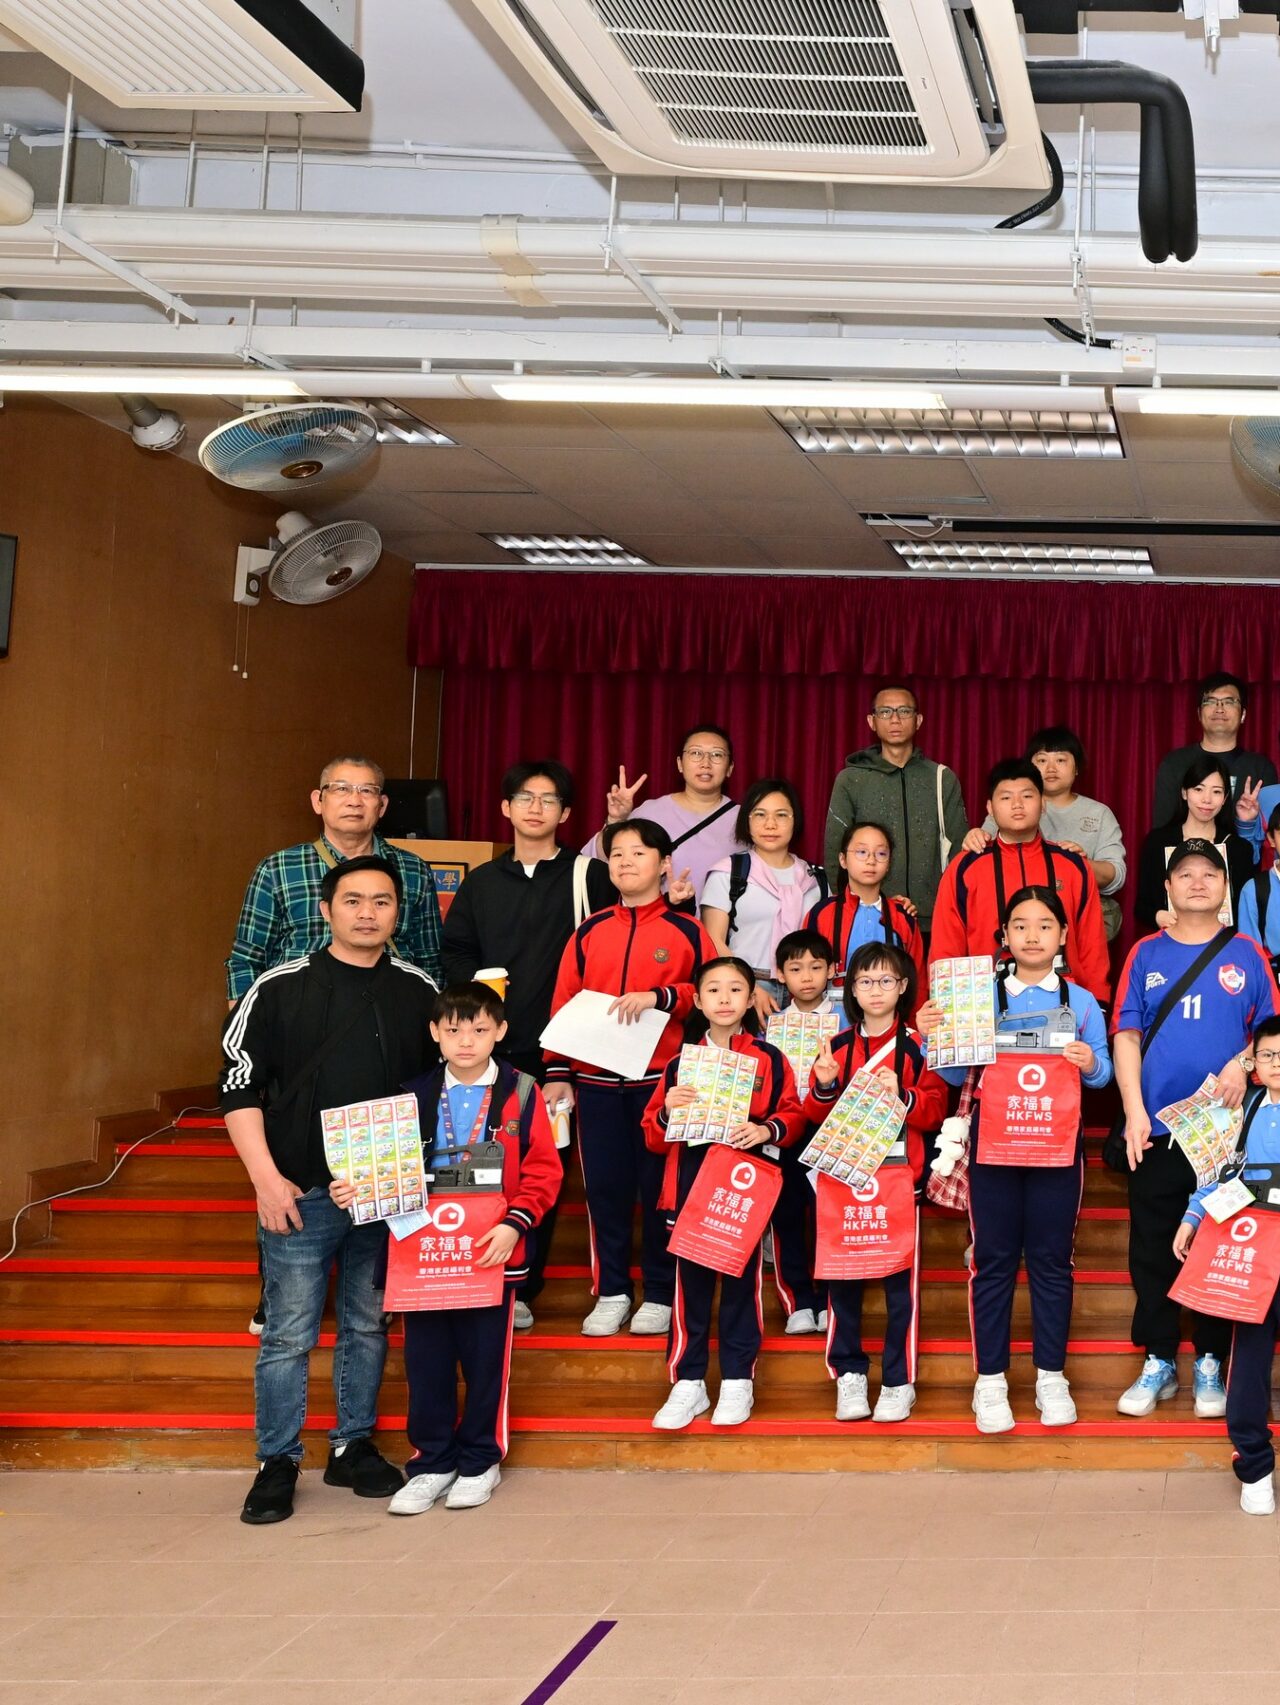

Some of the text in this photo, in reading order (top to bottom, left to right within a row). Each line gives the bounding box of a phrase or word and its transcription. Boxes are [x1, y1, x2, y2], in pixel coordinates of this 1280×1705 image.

[1146, 971, 1167, 983] EA
[1181, 993, 1202, 1020] 11
[1007, 1095, 1054, 1111] 家福會
[1006, 1110, 1053, 1122] HKFWS
[711, 1187, 755, 1213] 家福會
[707, 1201, 749, 1223] HKFWS
[843, 1204, 888, 1220] 家福會
[843, 1219, 888, 1231] HKFWS
[420, 1234, 475, 1252] 家福會
[419, 1250, 473, 1262] HKFWS
[1215, 1244, 1257, 1263] 家福會
[1210, 1258, 1254, 1274] HKFWS
